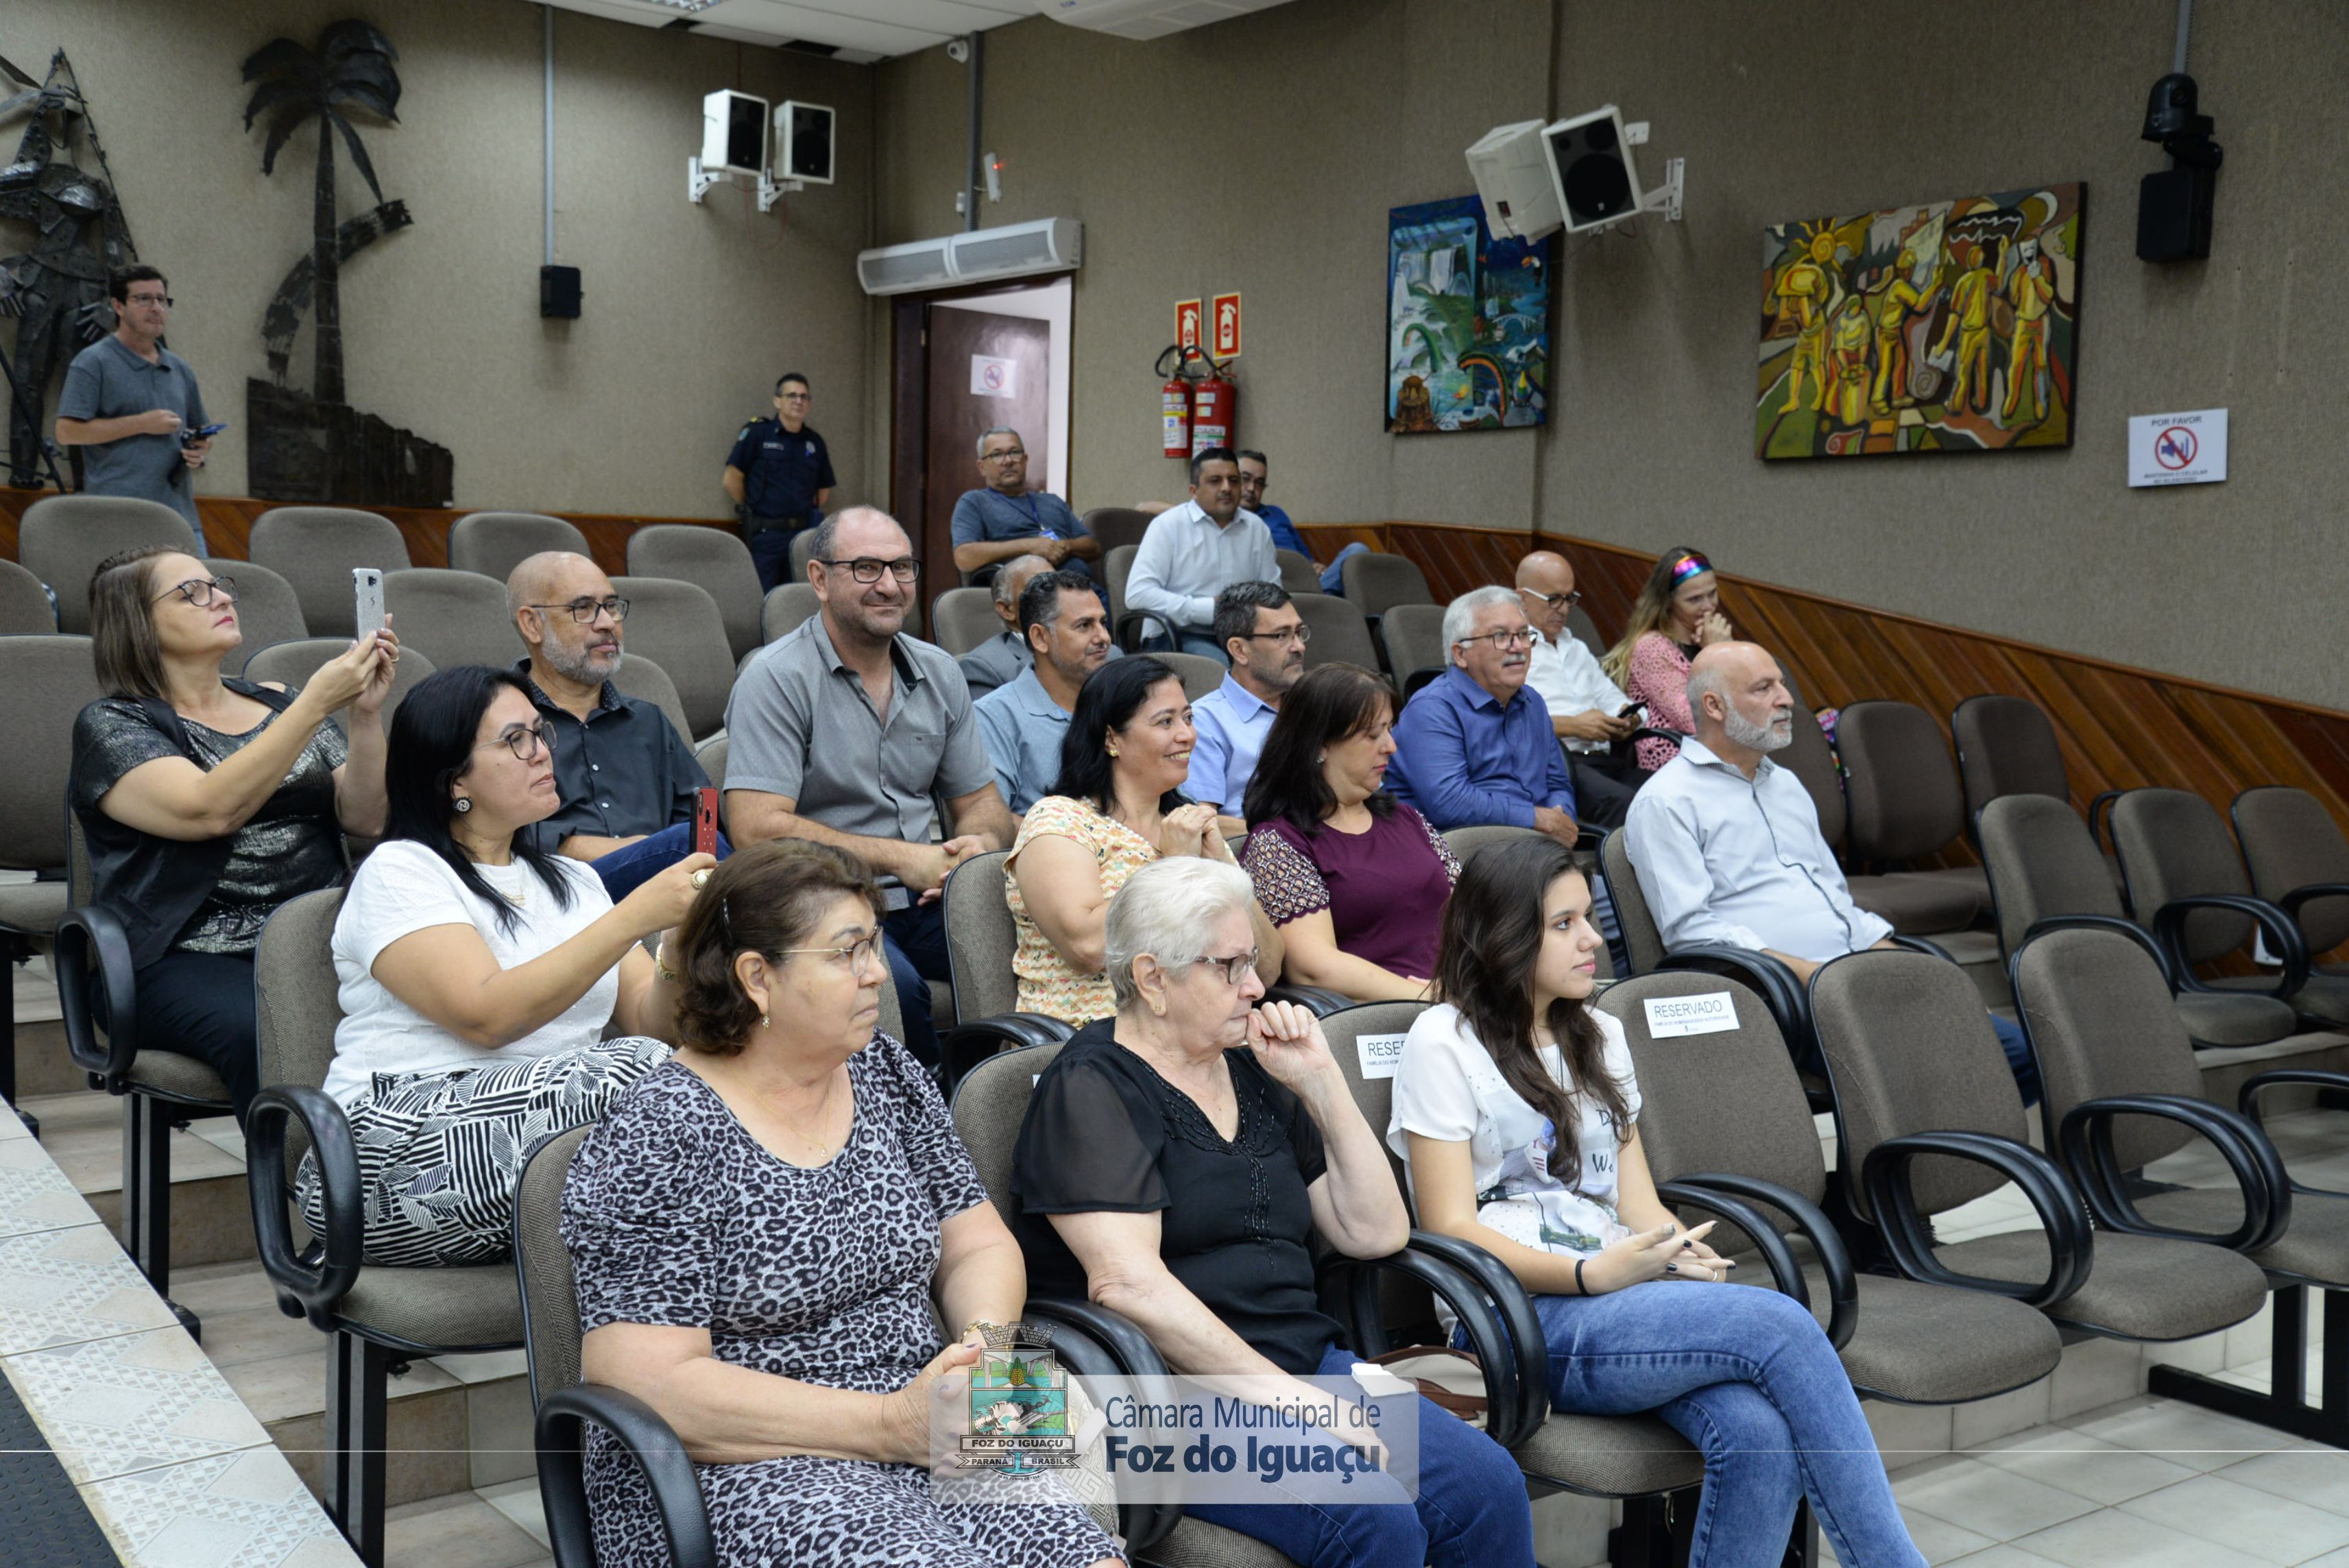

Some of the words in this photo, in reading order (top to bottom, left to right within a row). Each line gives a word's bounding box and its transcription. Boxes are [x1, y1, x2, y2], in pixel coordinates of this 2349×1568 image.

[2152, 418, 2169, 426] POR
[2172, 415, 2202, 425] FAVOR
[1654, 1000, 1722, 1018] RESERVADO
